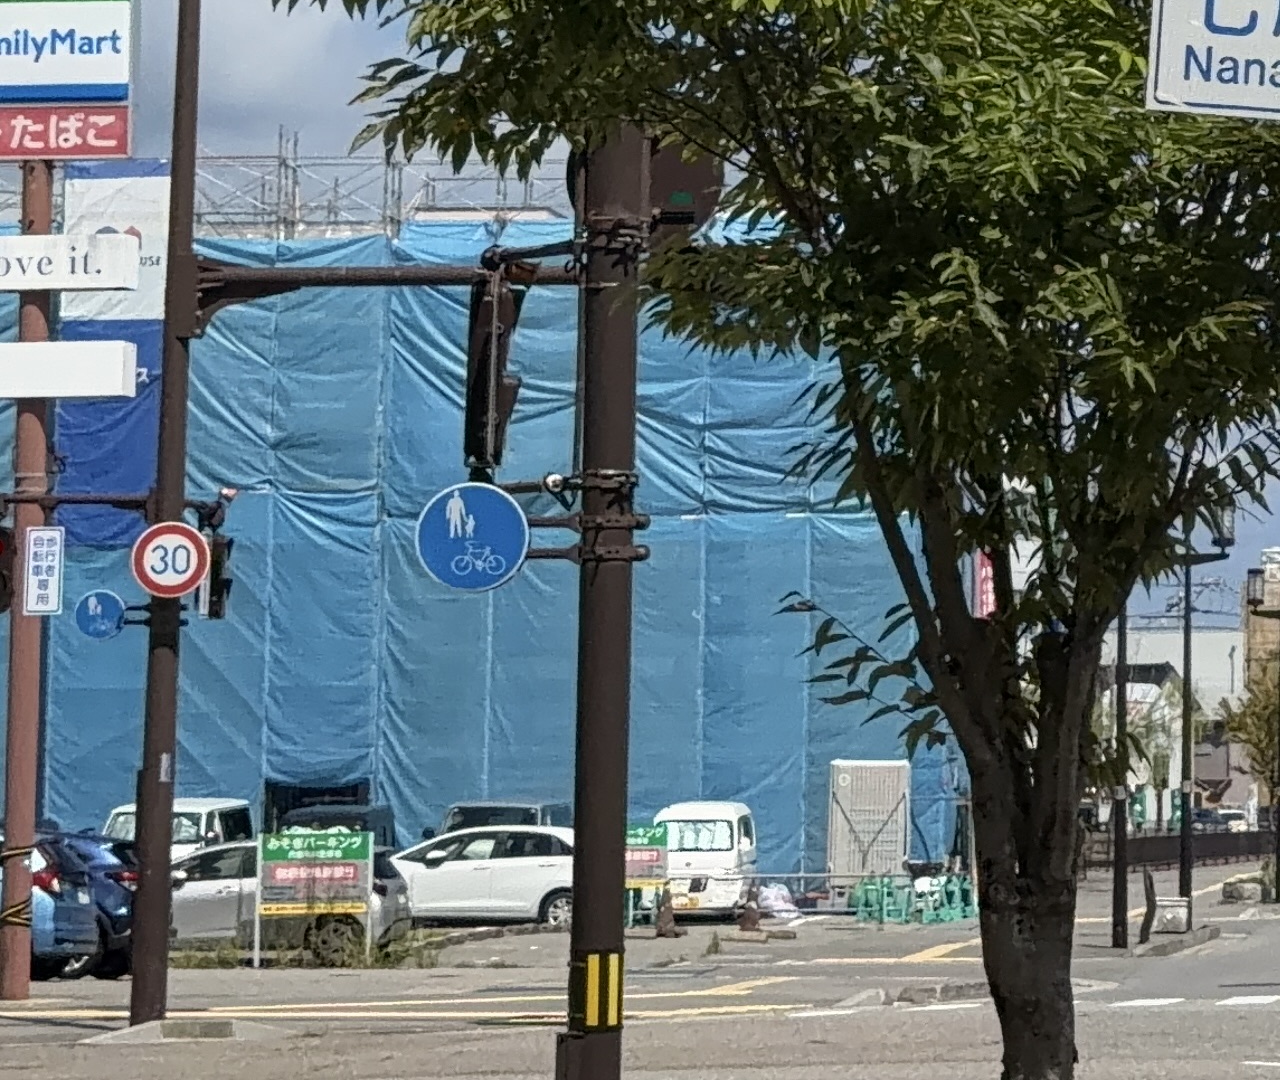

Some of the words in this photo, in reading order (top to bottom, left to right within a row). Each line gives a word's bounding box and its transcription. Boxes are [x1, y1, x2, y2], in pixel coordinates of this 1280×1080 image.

[10, 112, 118, 149] たばこ
[69, 245, 103, 276] it.
[150, 543, 192, 576] 30
